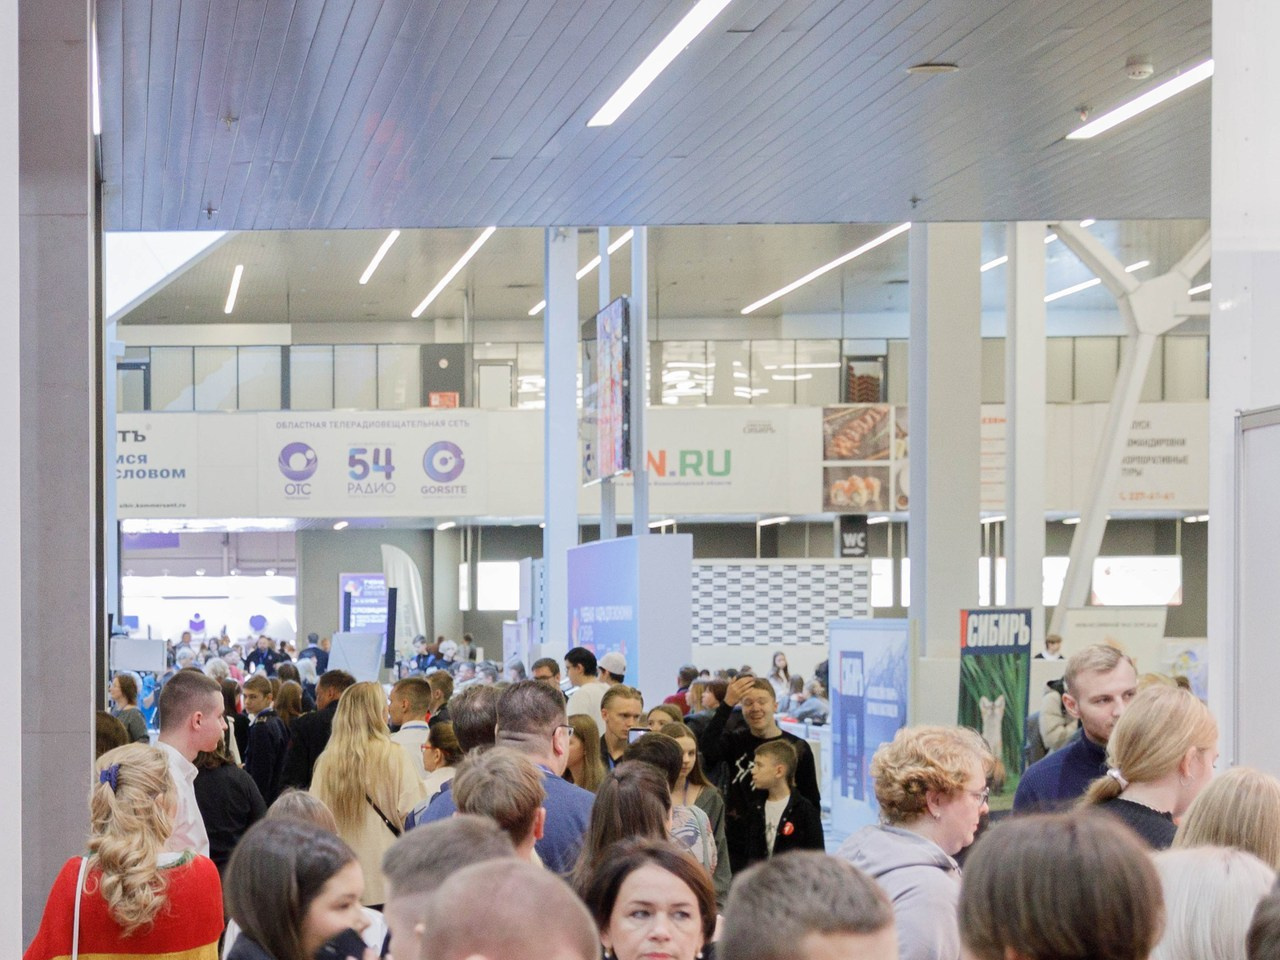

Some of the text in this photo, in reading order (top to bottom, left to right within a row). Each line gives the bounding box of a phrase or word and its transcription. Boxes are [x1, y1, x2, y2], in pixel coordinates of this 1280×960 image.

[276, 419, 470, 429] ОБЛАСТНАЯ ТЕЛЕРАДИОВЕЩАТЕЛЬНАЯ СЕТЬ
[348, 447, 395, 481] 54
[347, 482, 396, 494] РАДИО
[421, 485, 467, 494] GORSITE
[842, 532, 866, 548] WC
[967, 613, 1031, 648] СИБИРЬ
